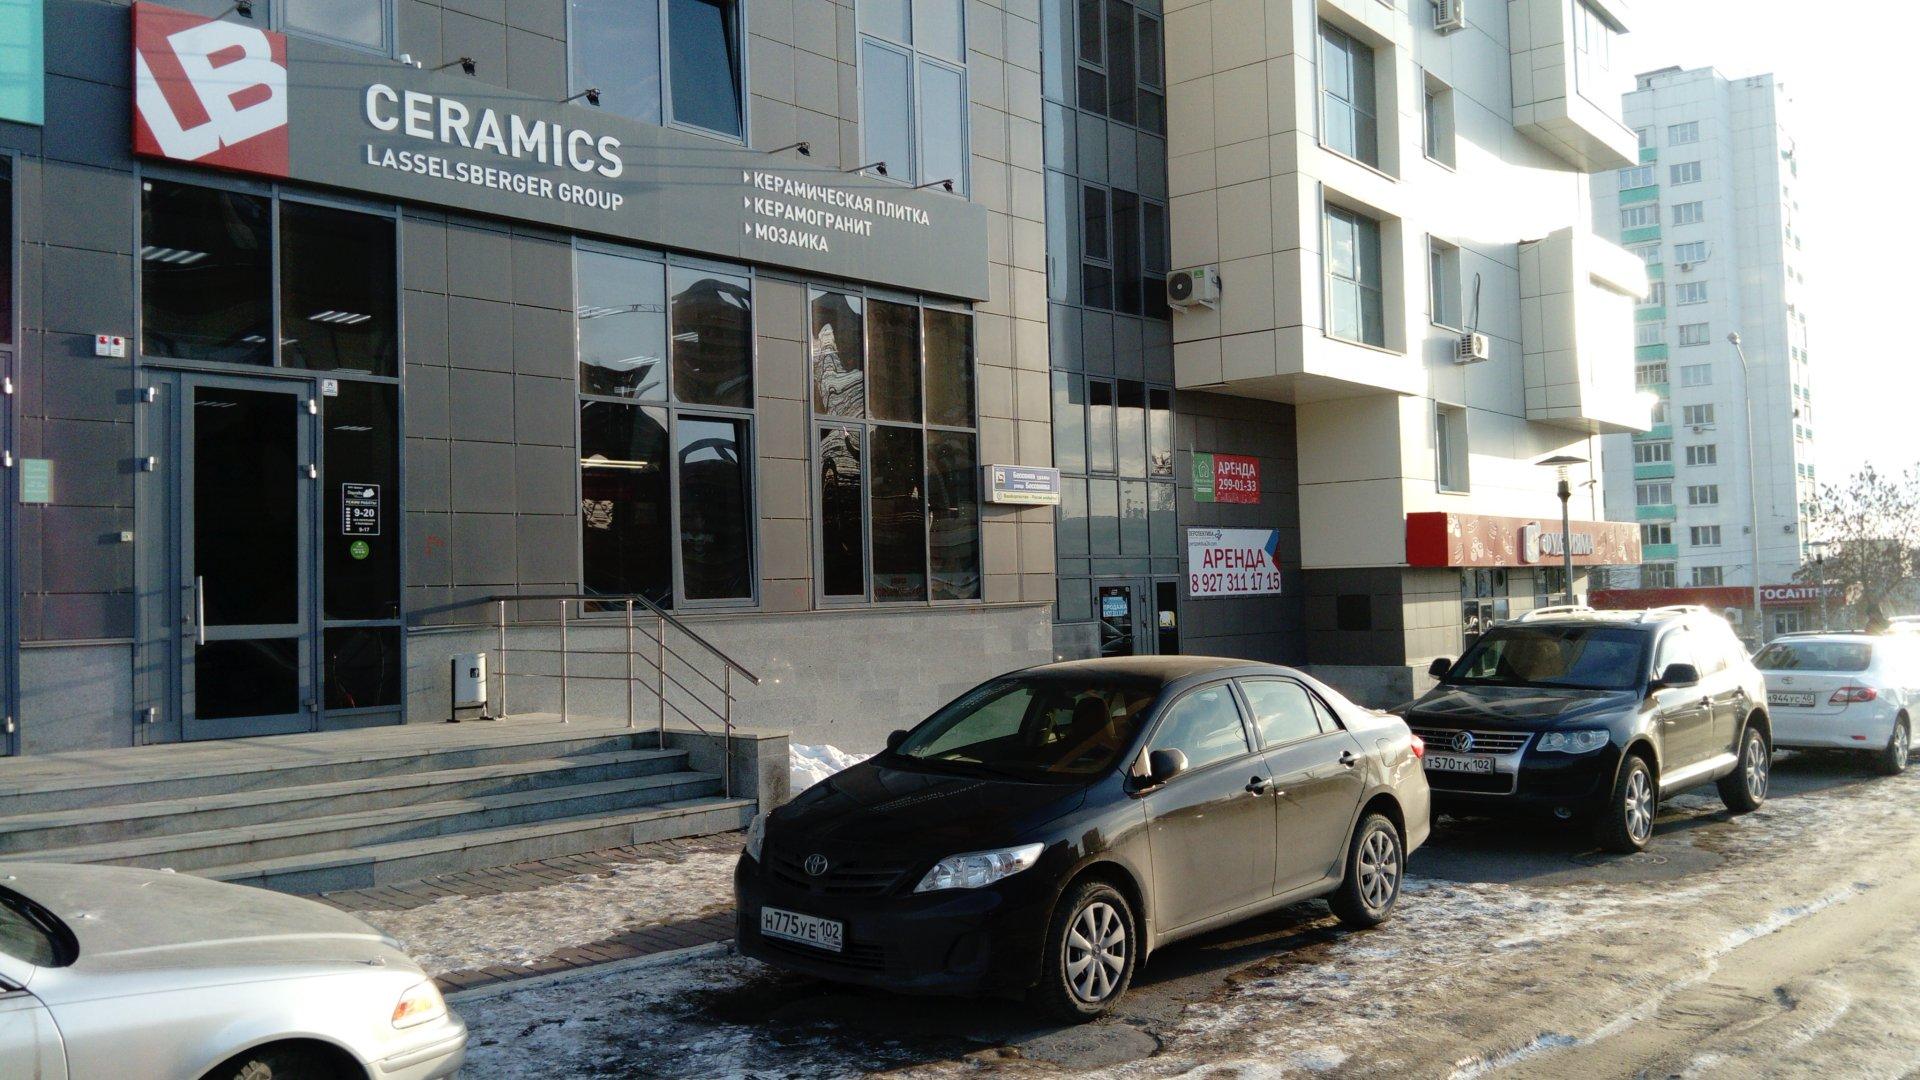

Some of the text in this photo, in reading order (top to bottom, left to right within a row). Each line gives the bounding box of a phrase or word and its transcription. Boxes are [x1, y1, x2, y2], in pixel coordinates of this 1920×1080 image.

[366, 83, 623, 178] CERAMICS
[367, 144, 624, 211] LASSELSBERGER GROUP
[754, 171, 930, 226] КЕРАМИЧЕСКАЯ ПЛИТКА
[754, 197, 872, 237] КЕРАМОГРАНИТ
[755, 223, 829, 252] МОЗАИКА
[1218, 461, 1256, 478] АРЕНДА
[1218, 478, 1257, 492] 299-01-33
[354, 508, 375, 517] 9-20
[1203, 548, 1266, 572] АРЕНДА
[1191, 572, 1280, 592] 8 927 311 17 15
[1473, 759, 1490, 770] 102
[765, 912, 839, 939] Н775УЕ 102
